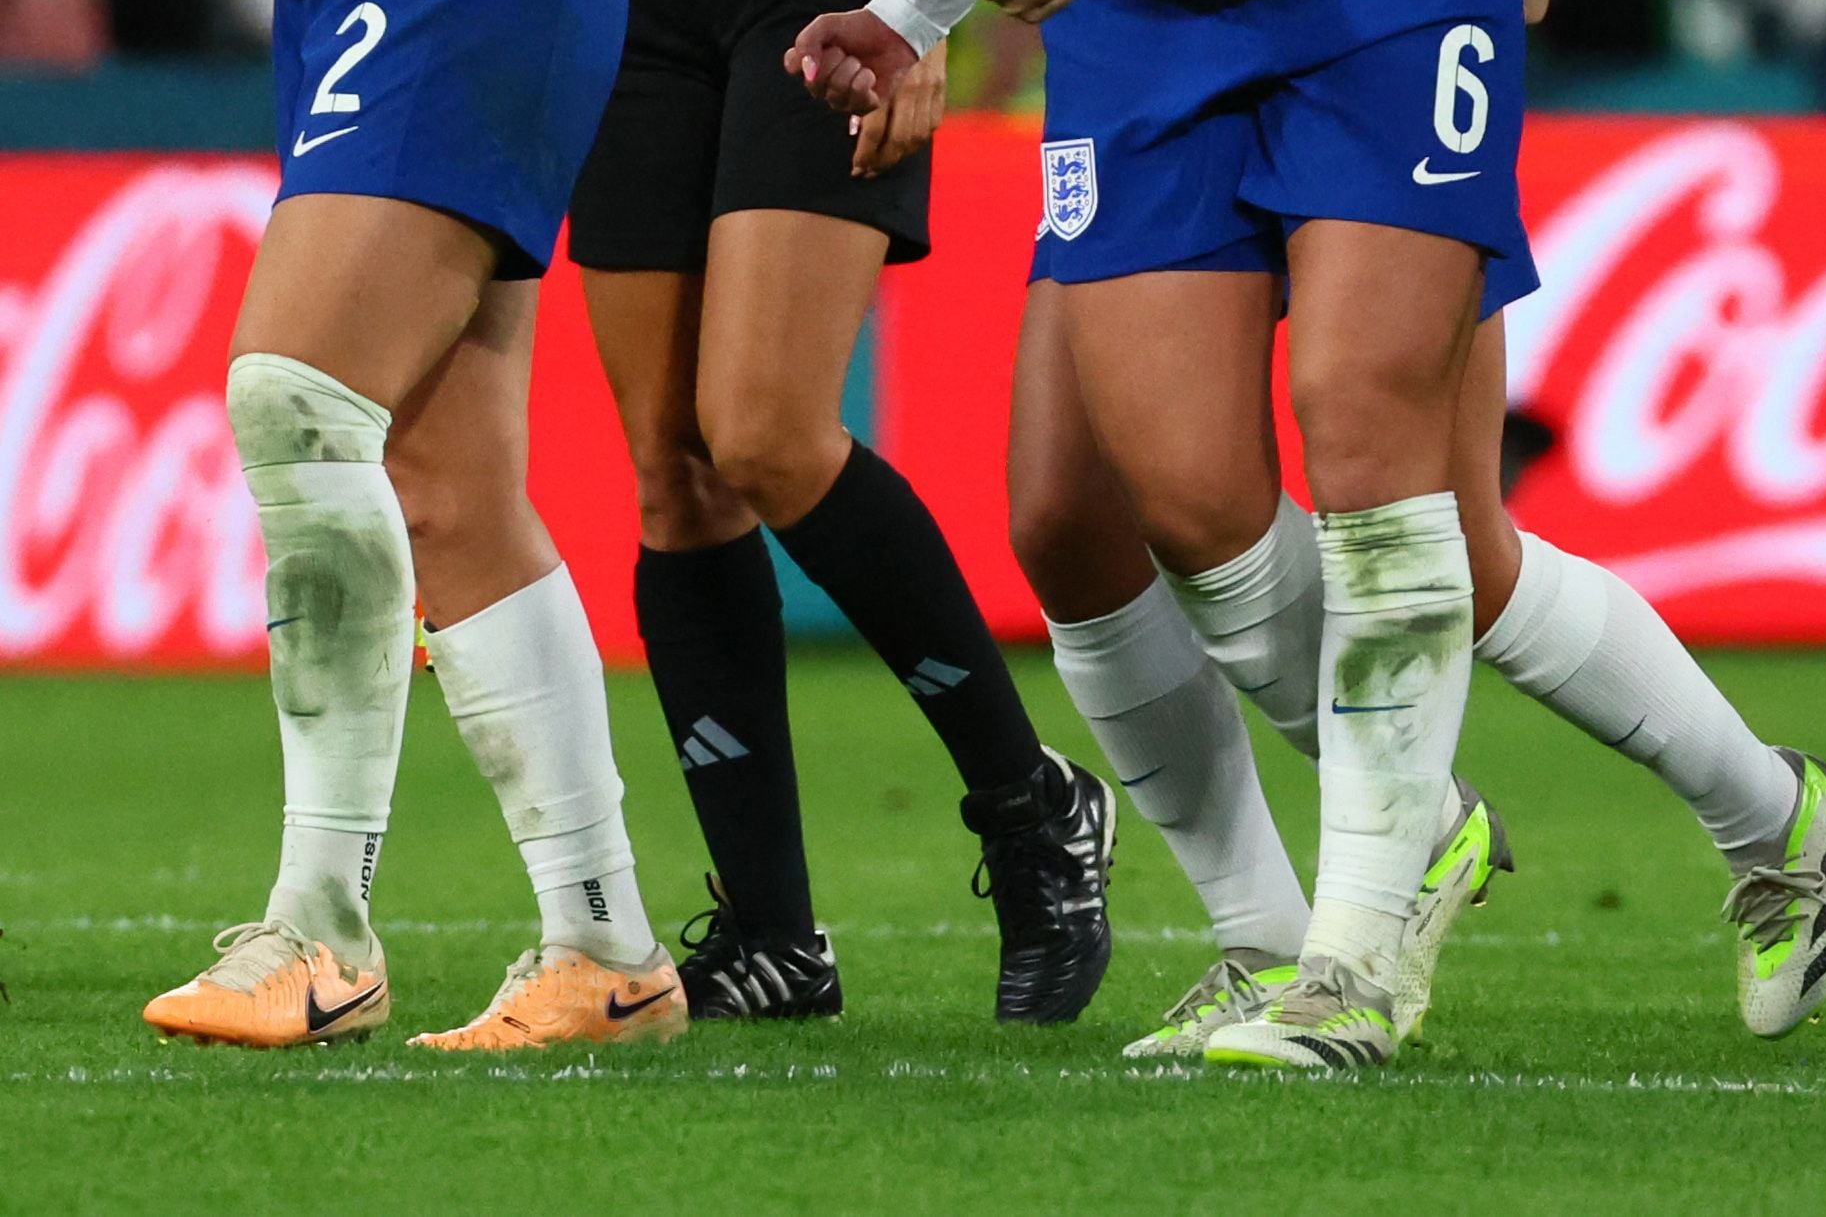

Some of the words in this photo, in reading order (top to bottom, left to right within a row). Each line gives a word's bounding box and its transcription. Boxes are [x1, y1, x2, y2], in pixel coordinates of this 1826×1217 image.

[310, 1, 387, 116] 2
[1433, 24, 1495, 154] 6
[361, 832, 379, 902] ESIGN
[583, 878, 613, 922] SIGN
